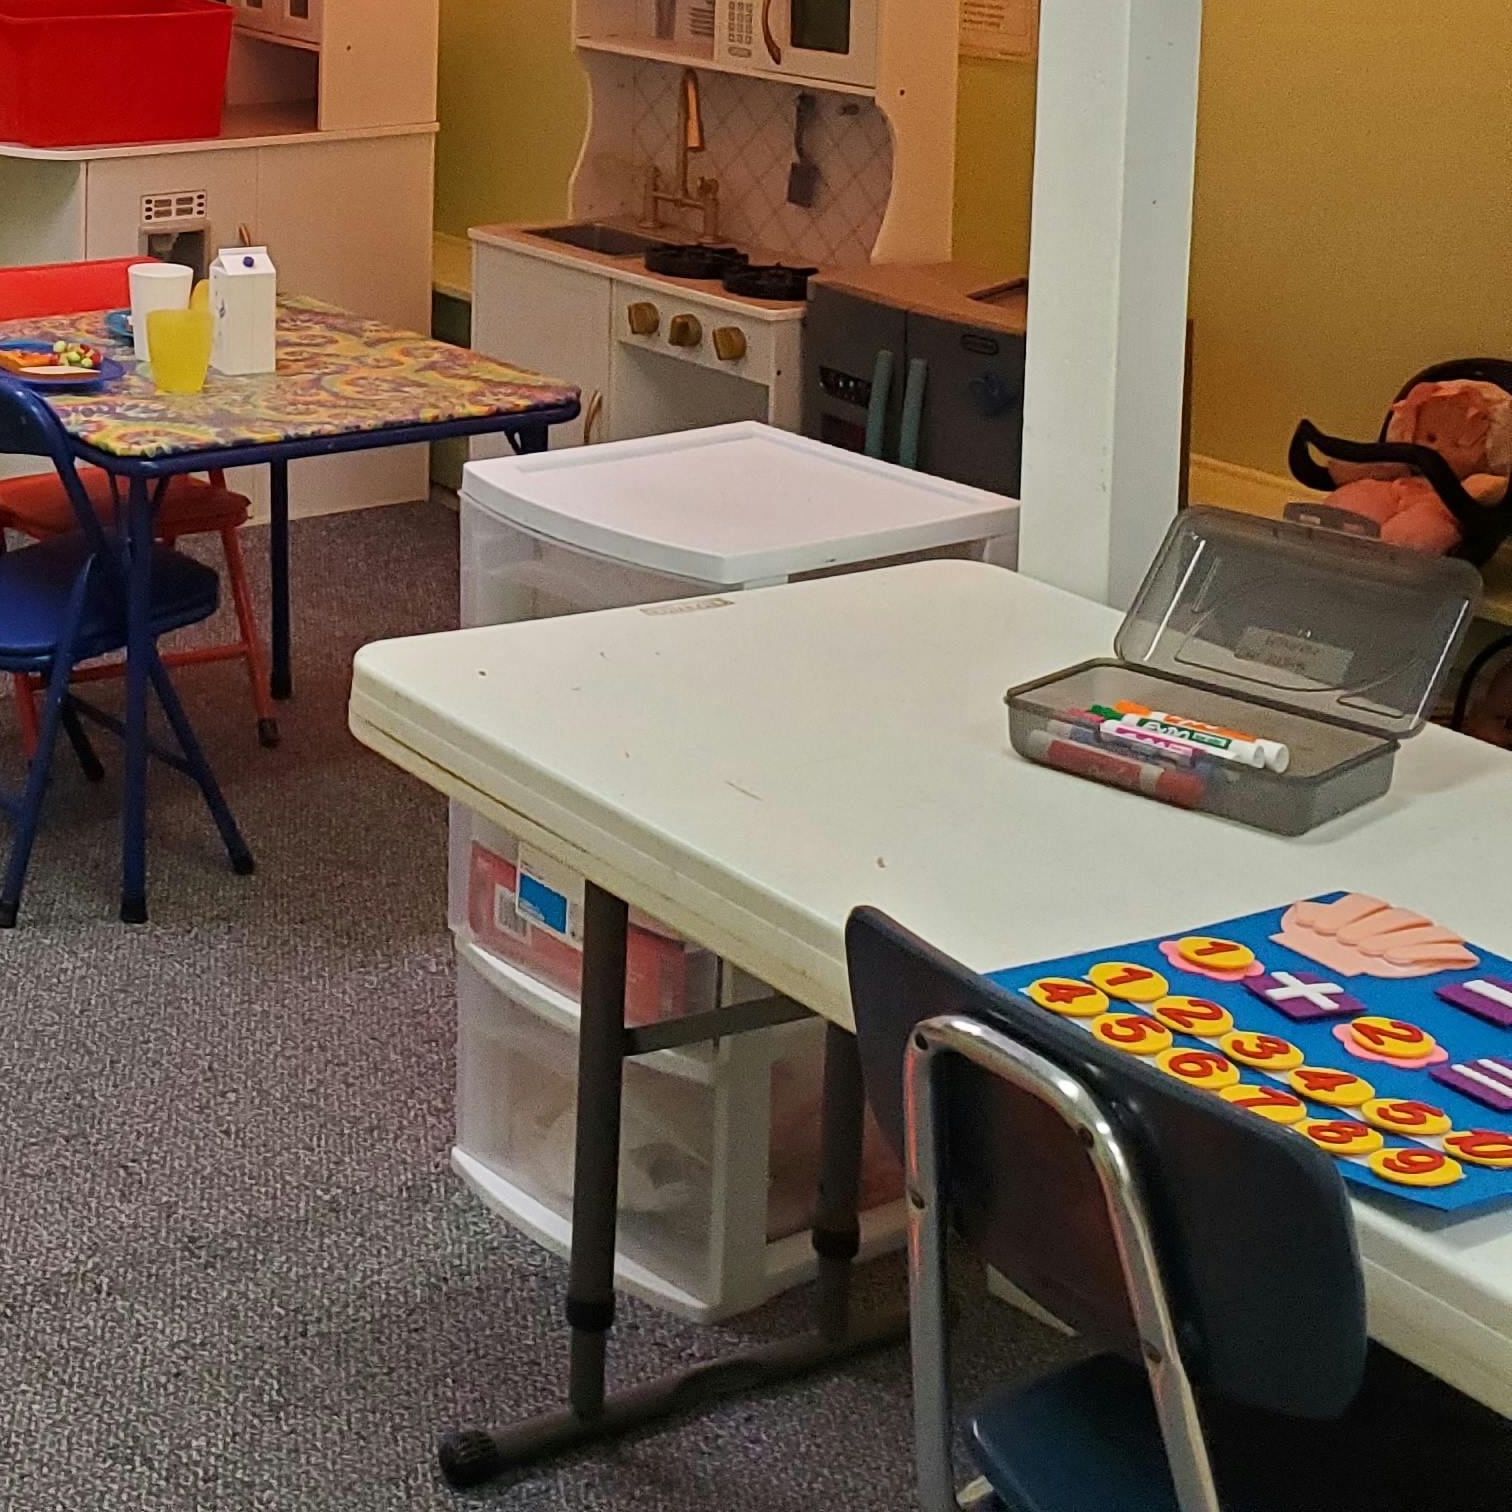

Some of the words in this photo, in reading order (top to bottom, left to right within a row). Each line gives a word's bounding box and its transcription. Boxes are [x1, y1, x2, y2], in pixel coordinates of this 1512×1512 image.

[1038, 982, 1096, 1003] 4
[1100, 1015, 1165, 1043] 5
[1307, 1120, 1369, 1144] 8
[1105, 967, 1153, 986] 1
[1157, 999, 1224, 1028] 2
[1231, 1035, 1290, 1059] 3
[1293, 1069, 1358, 1092] 4
[1376, 1101, 1444, 1125] 5
[1194, 941, 1240, 956] 1
[1351, 1020, 1424, 1046] 2
